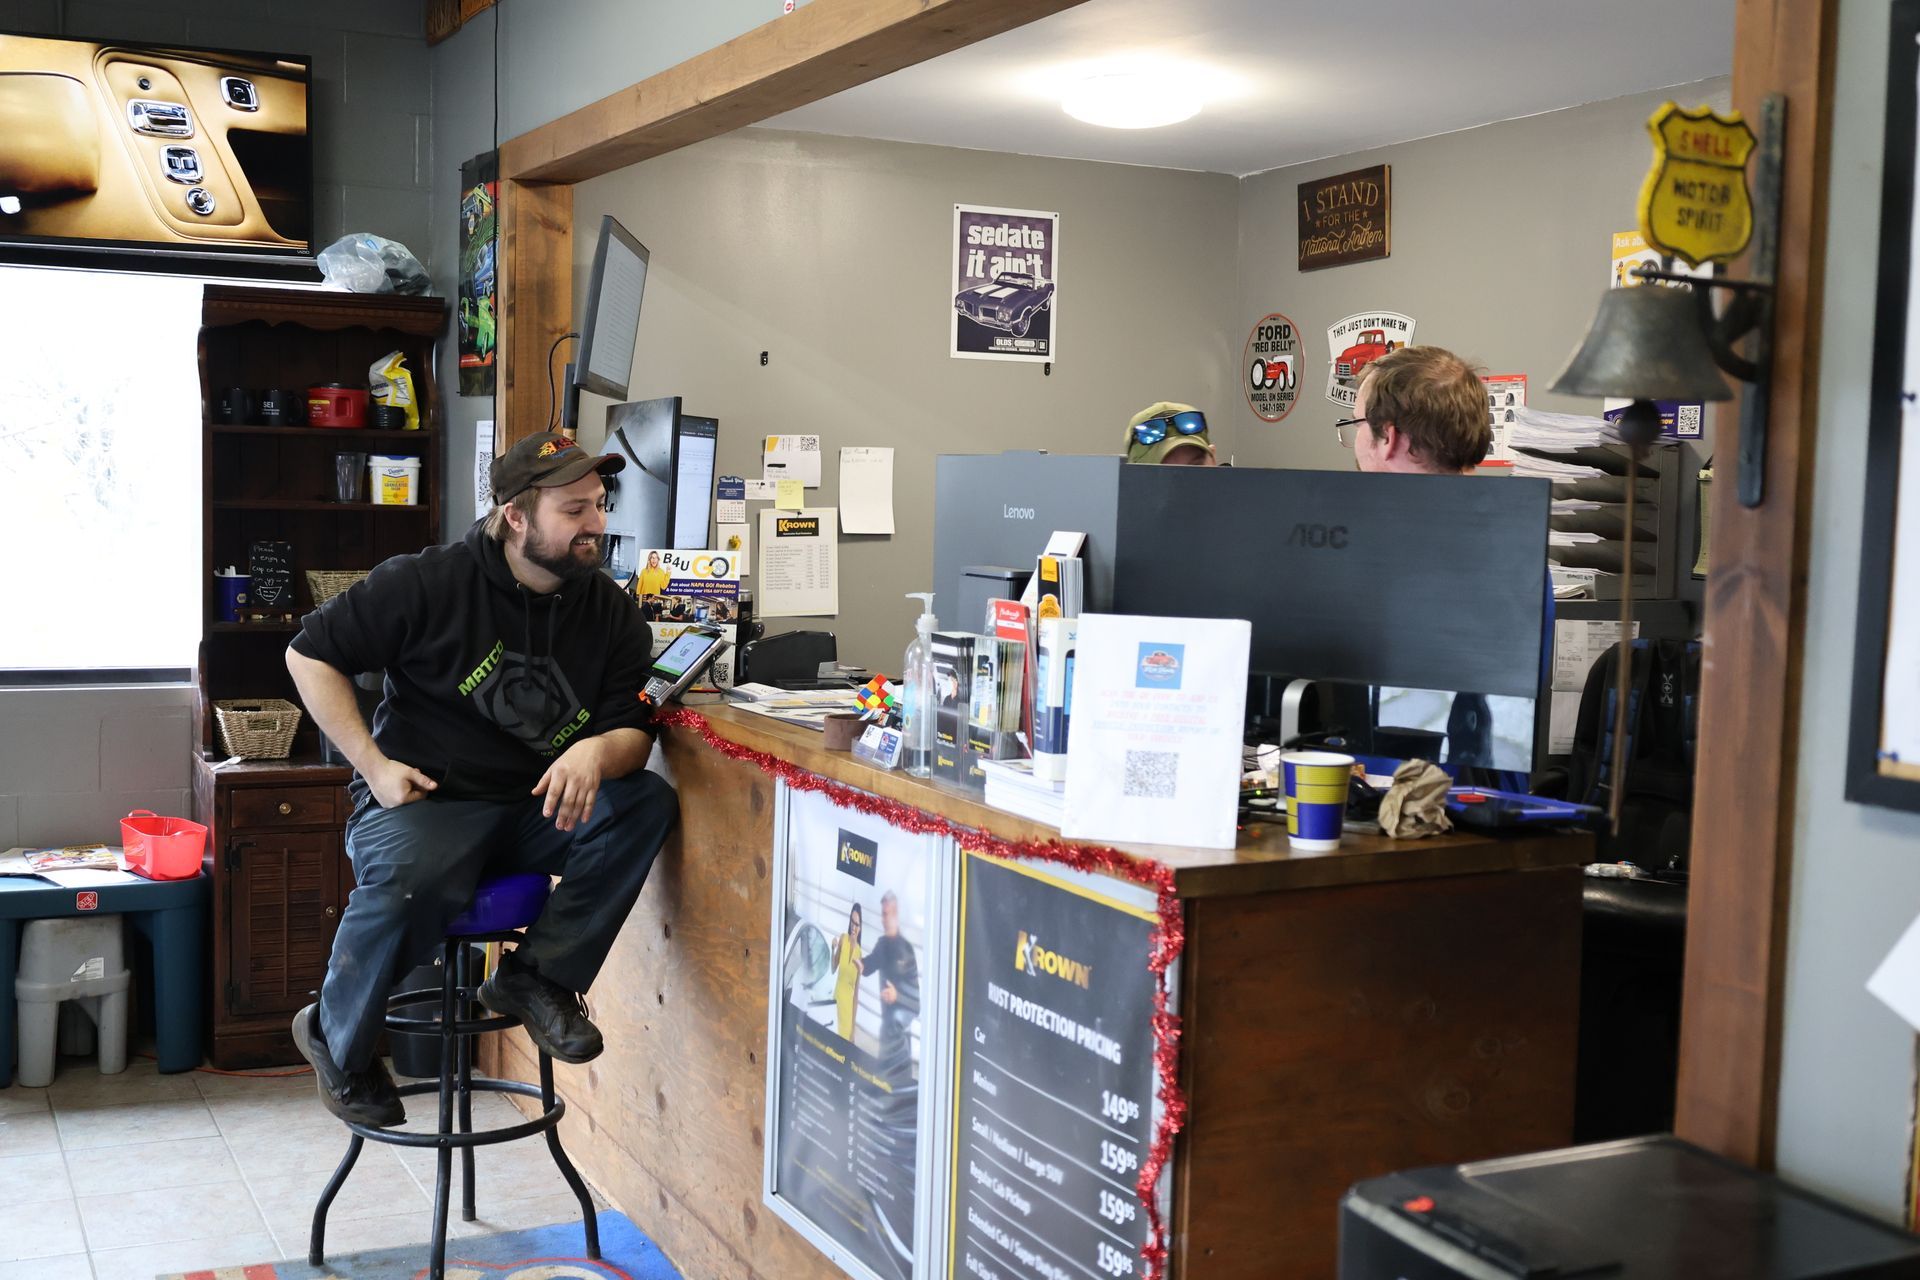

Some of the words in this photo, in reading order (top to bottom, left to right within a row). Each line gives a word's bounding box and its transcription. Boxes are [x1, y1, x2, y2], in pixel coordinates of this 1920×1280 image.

[1681, 130, 1732, 157] SHELL
[1304, 200, 1311, 221] I
[1316, 181, 1379, 213] STAND
[1674, 178, 1731, 204] MOTOR
[1323, 213, 1340, 228] FOR
[1344, 209, 1360, 223] THE
[1677, 208, 1723, 231] SPIRIT
[967, 223, 1045, 250] sedate
[1301, 229, 1345, 259] National
[1343, 221, 1383, 251] Anthem
[1616, 236, 1631, 248] Ask
[966, 249, 986, 278] it
[989, 251, 1044, 280] ain't
[1258, 324, 1291, 341] FORD
[1333, 326, 1346, 338] THEY
[1348, 319, 1362, 332] JUST
[1363, 317, 1380, 328] DON'T
[1381, 317, 1397, 329] MAKE
[996, 338, 1012, 346] OLDS
[1251, 392, 1268, 402] MODEL
[1276, 392, 1294, 401] SERIES
[1331, 386, 1347, 401] LIKE
[1259, 403, 1286, 412] 1947-1952
[1003, 503, 1035, 520] Lenovo
[778, 519, 816, 532] KROWN
[1287, 523, 1348, 549] AOC
[663, 553, 690, 571] B4U
[692, 554, 736, 578] GO!
[458, 640, 504, 696] MATCO
[551, 708, 591, 749] OOLS
[841, 839, 874, 869] KROWN
[1015, 930, 1090, 990] KROWN
[974, 1026, 986, 1044] Car
[988, 981, 1010, 1010] RUST
[1010, 993, 1076, 1042] PROTECTION
[1077, 1024, 1121, 1065] PRICING
